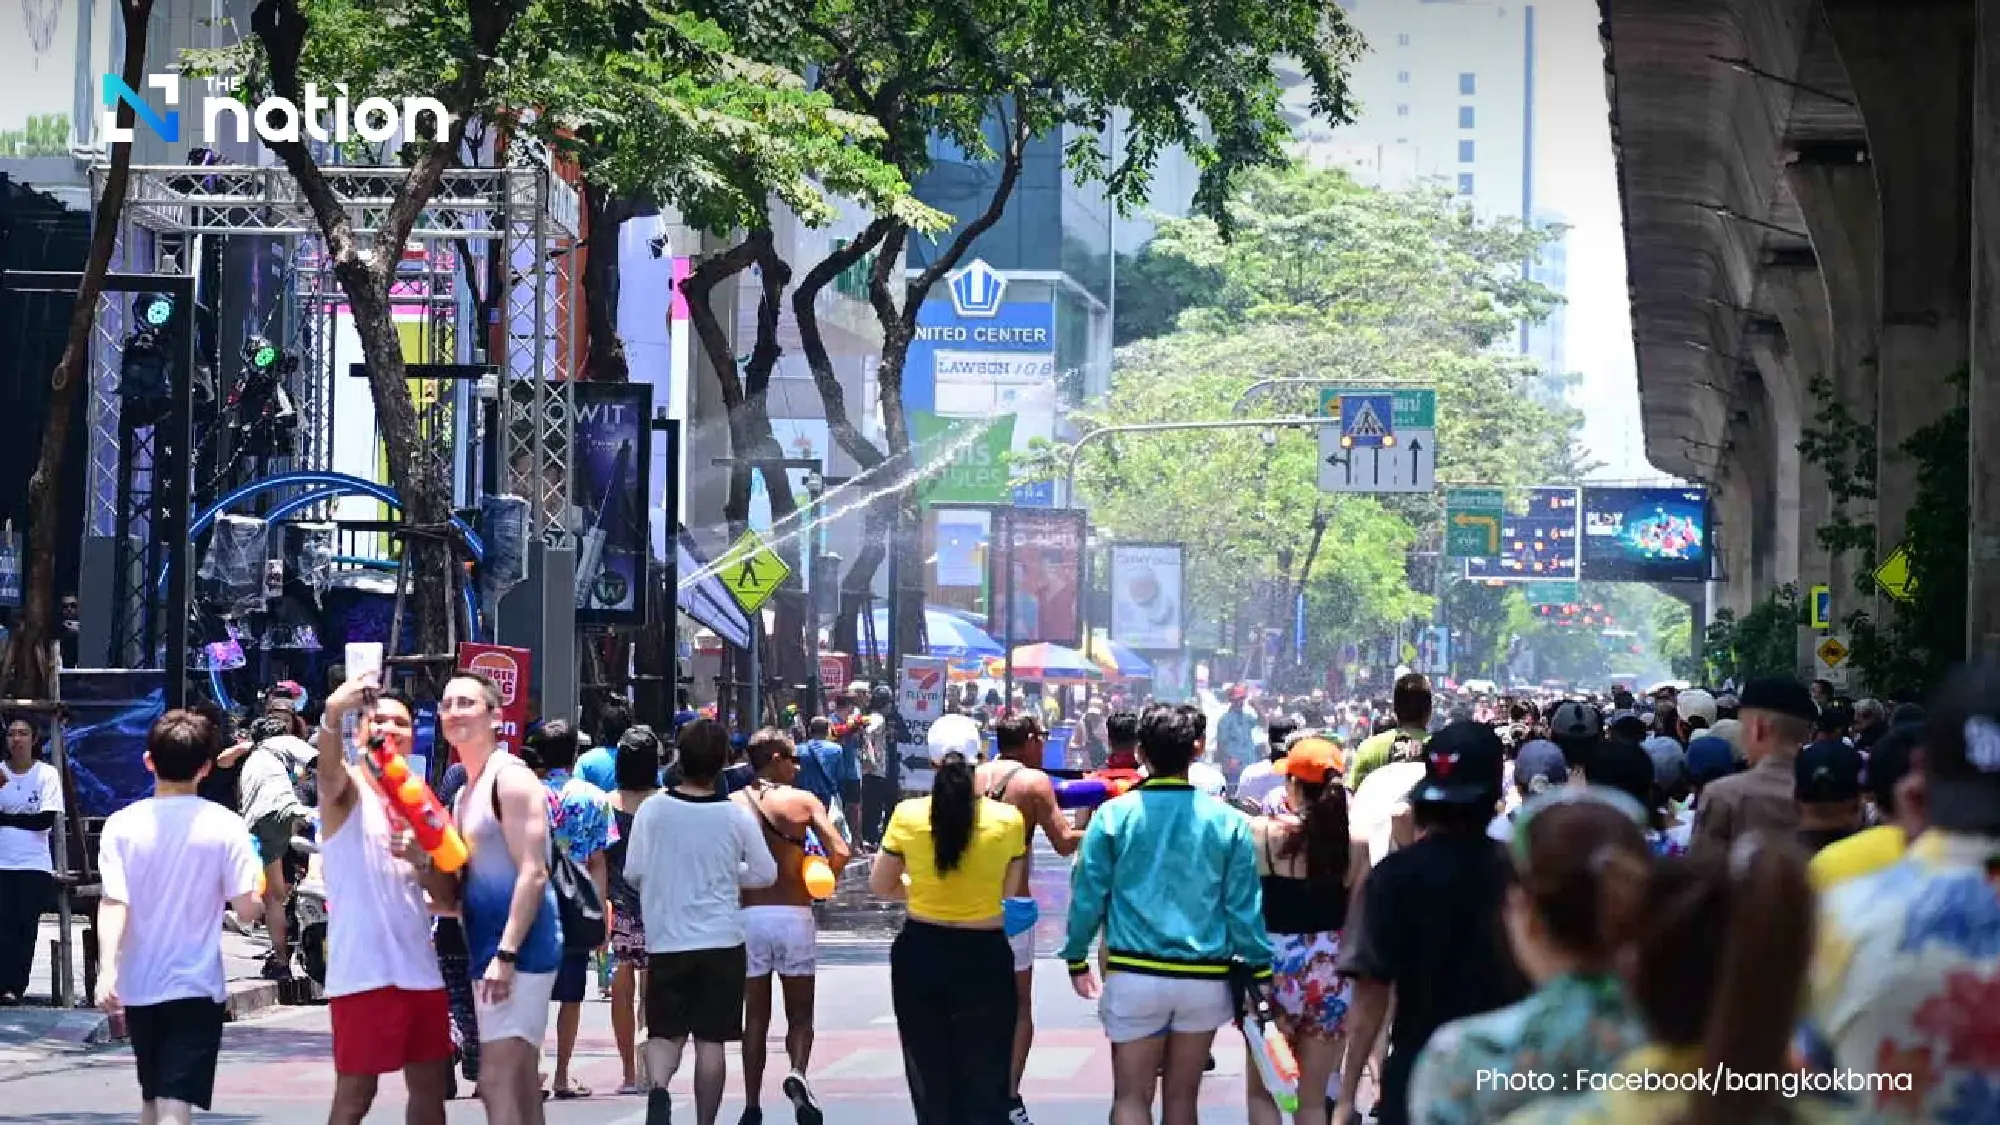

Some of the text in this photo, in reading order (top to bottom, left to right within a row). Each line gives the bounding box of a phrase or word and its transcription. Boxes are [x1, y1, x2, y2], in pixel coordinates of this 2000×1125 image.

[914, 327, 1047, 343] NITED CENTER
[904, 720, 934, 735] OPE
